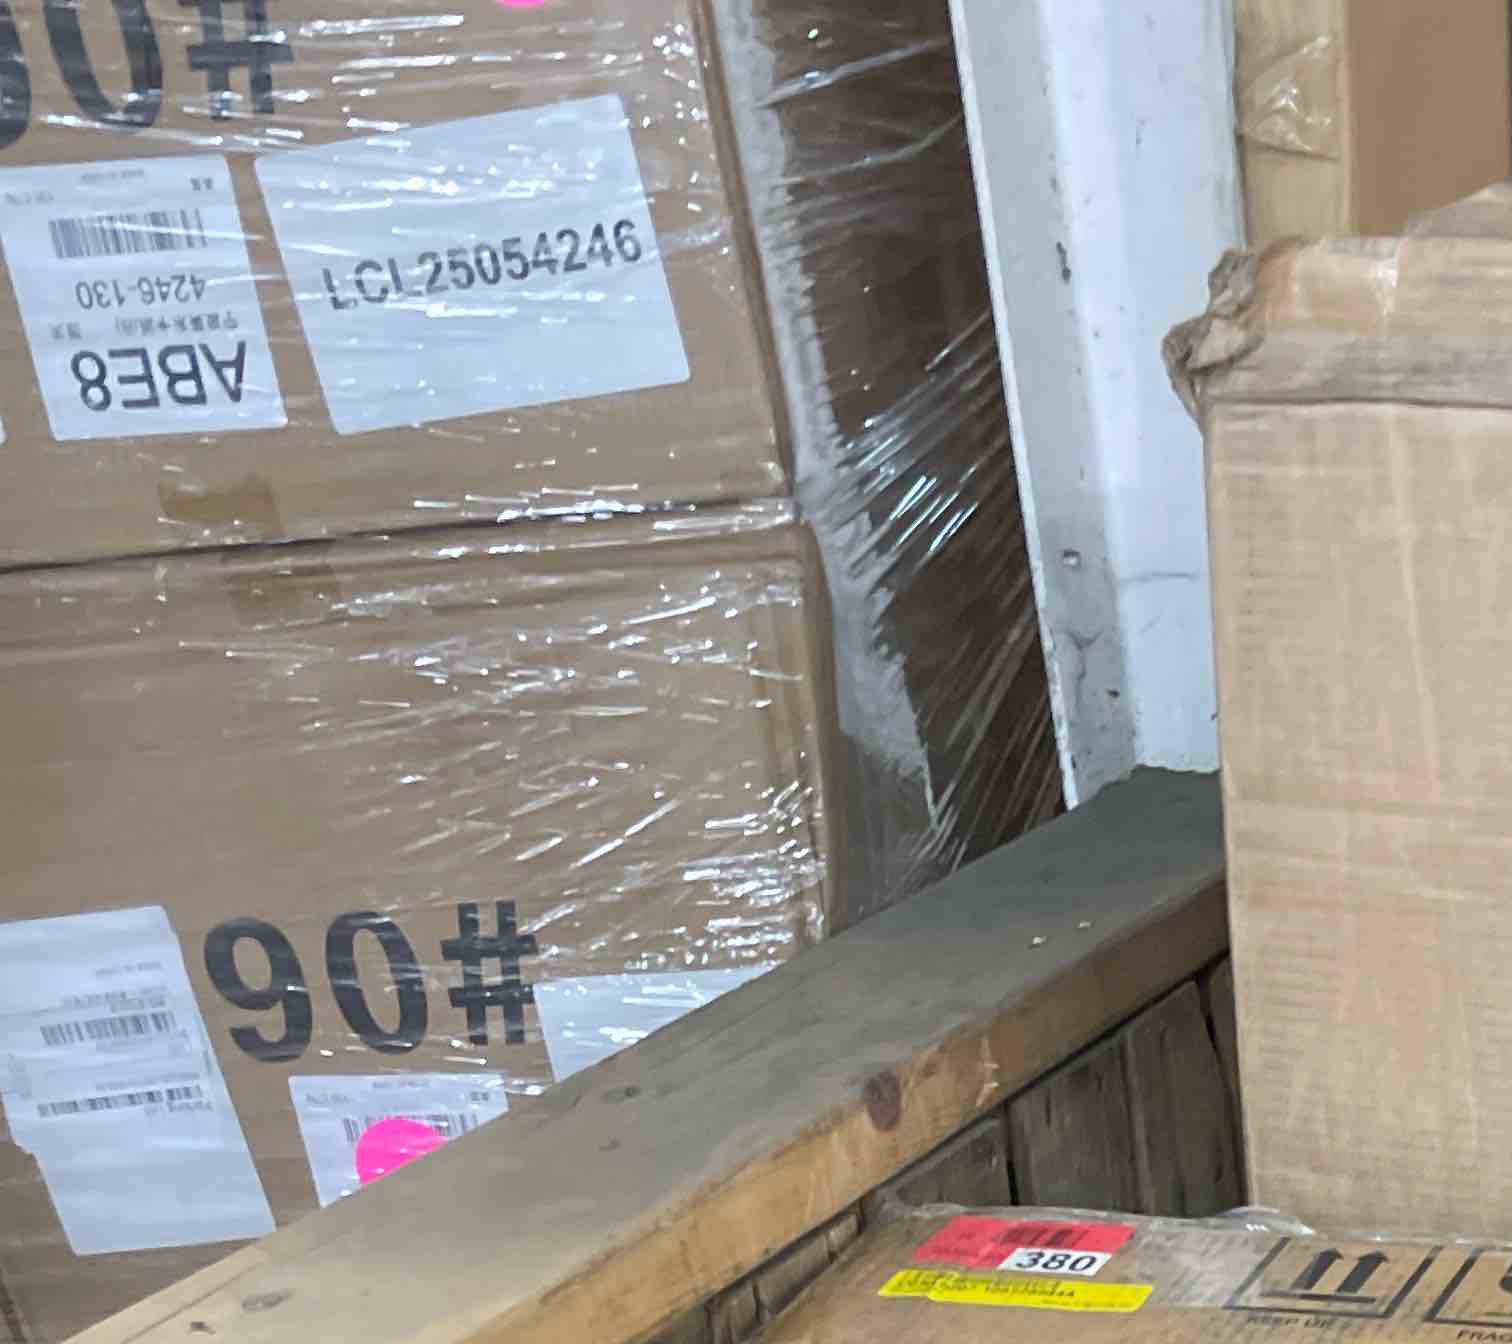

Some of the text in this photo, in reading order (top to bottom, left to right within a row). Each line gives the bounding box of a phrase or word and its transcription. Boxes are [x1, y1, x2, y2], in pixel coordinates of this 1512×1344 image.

[0, 0, 293, 149] 0#
[75, 277, 207, 311] 4246-130
[320, 217, 644, 312] LCL25054246
[70, 340, 249, 412] ABE8
[203, 900, 540, 1065] 90#
[1014, 1249, 1099, 1275] 380
